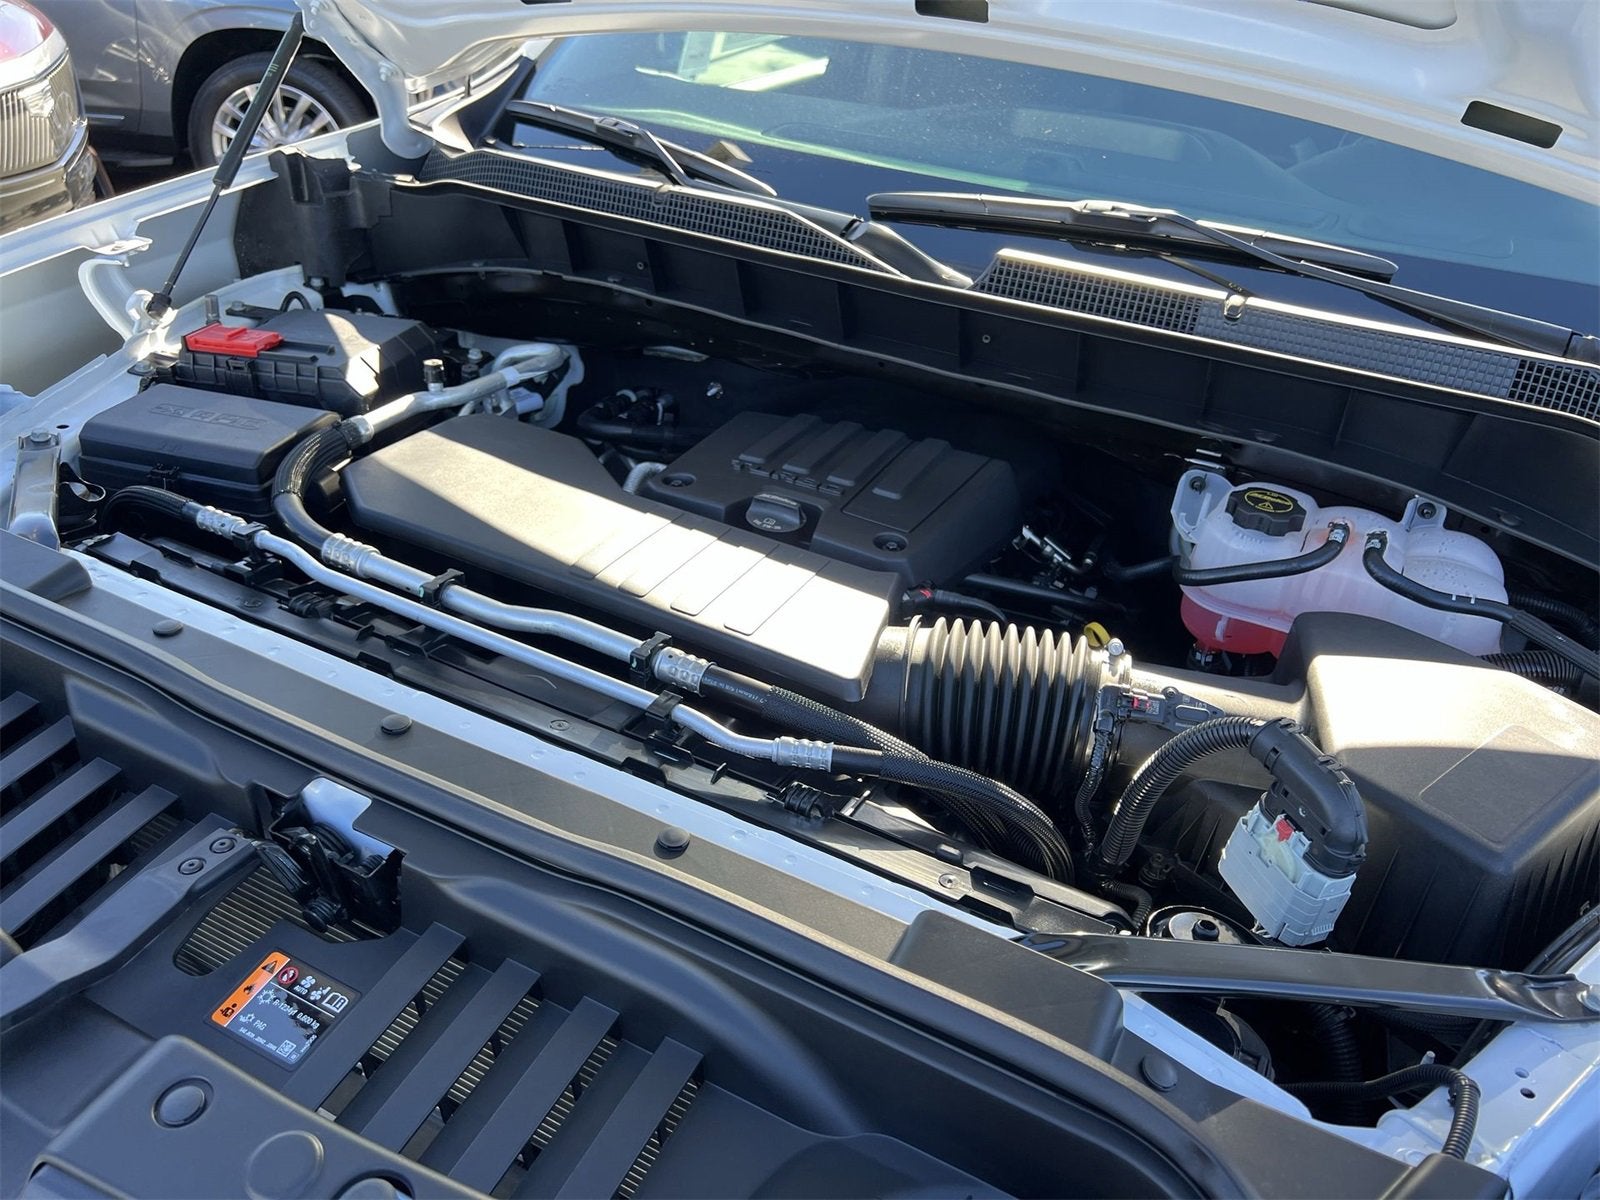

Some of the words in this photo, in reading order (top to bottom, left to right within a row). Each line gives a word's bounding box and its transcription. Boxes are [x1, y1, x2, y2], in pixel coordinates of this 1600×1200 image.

[293, 984, 308, 995] AUTO
[253, 1019, 267, 1031] PAG
[310, 1019, 320, 1030] kg
